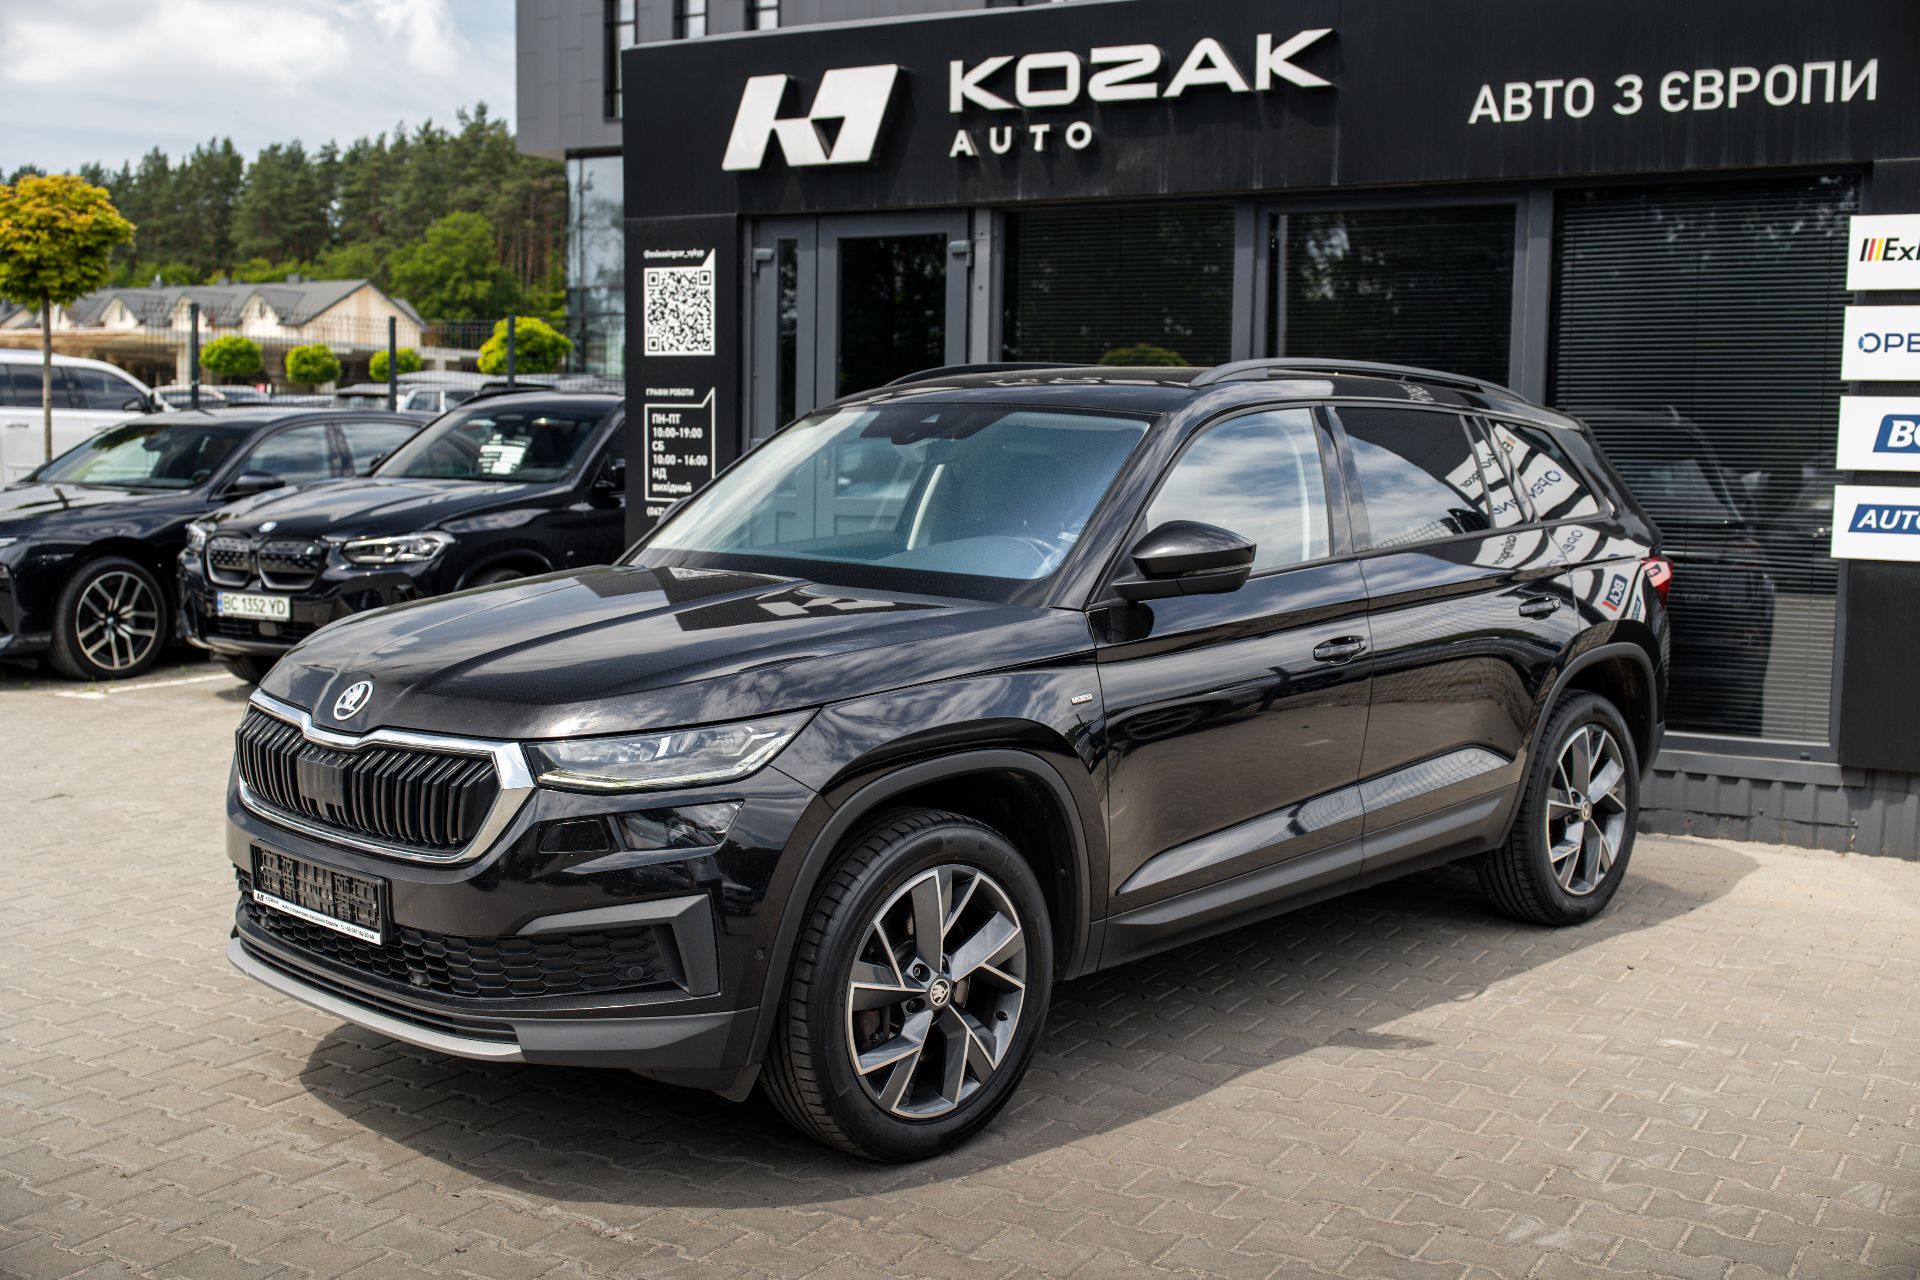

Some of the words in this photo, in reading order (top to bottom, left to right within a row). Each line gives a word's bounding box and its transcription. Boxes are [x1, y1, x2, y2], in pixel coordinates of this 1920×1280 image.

[948, 28, 1335, 114] KOZAK
[1467, 77, 1596, 125] АВТО
[1611, 74, 1644, 116] З
[1659, 58, 1879, 113] ЄВРОПИ
[949, 120, 1095, 159] AUTO
[652, 413, 681, 424] ПН-ПТ
[652, 427, 703, 439] 10:00-19:00
[651, 440, 665, 452] СБ
[652, 454, 676, 466] 10:00
[684, 454, 708, 467] 16:00
[651, 467, 667, 481] НД
[241, 598, 266, 613] 1352
[268, 600, 286, 615] YD
